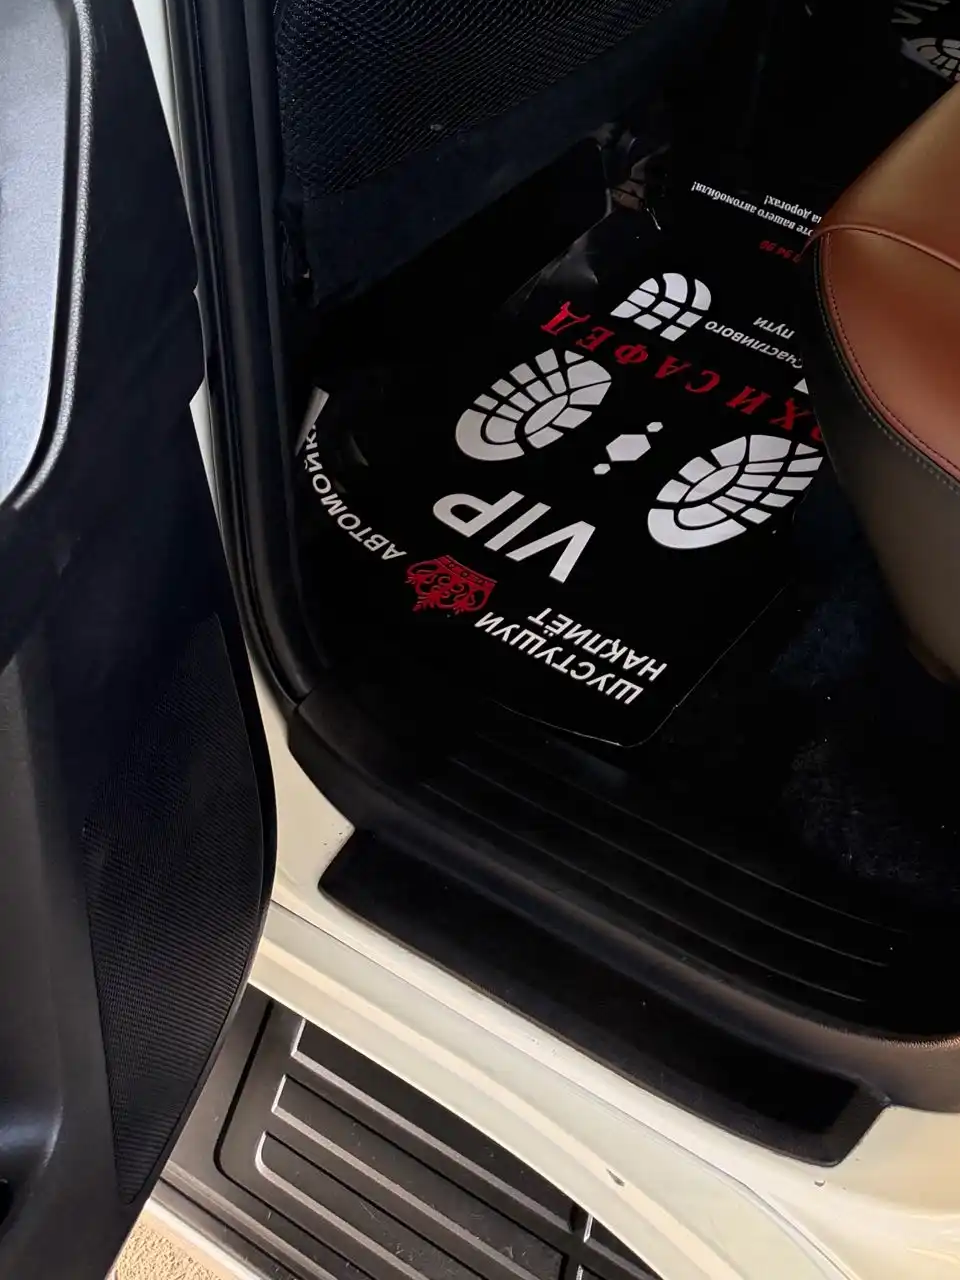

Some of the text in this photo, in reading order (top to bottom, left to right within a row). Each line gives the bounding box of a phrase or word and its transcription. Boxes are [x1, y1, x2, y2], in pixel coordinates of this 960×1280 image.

[690, 181, 757, 214] автомобиля!
[763, 195, 812, 220] дорогах!
[757, 208, 796, 230] вашего
[752, 317, 796, 340] пути
[303, 423, 407, 561] АВТОМОЙК
[432, 490, 596, 584] VIP
